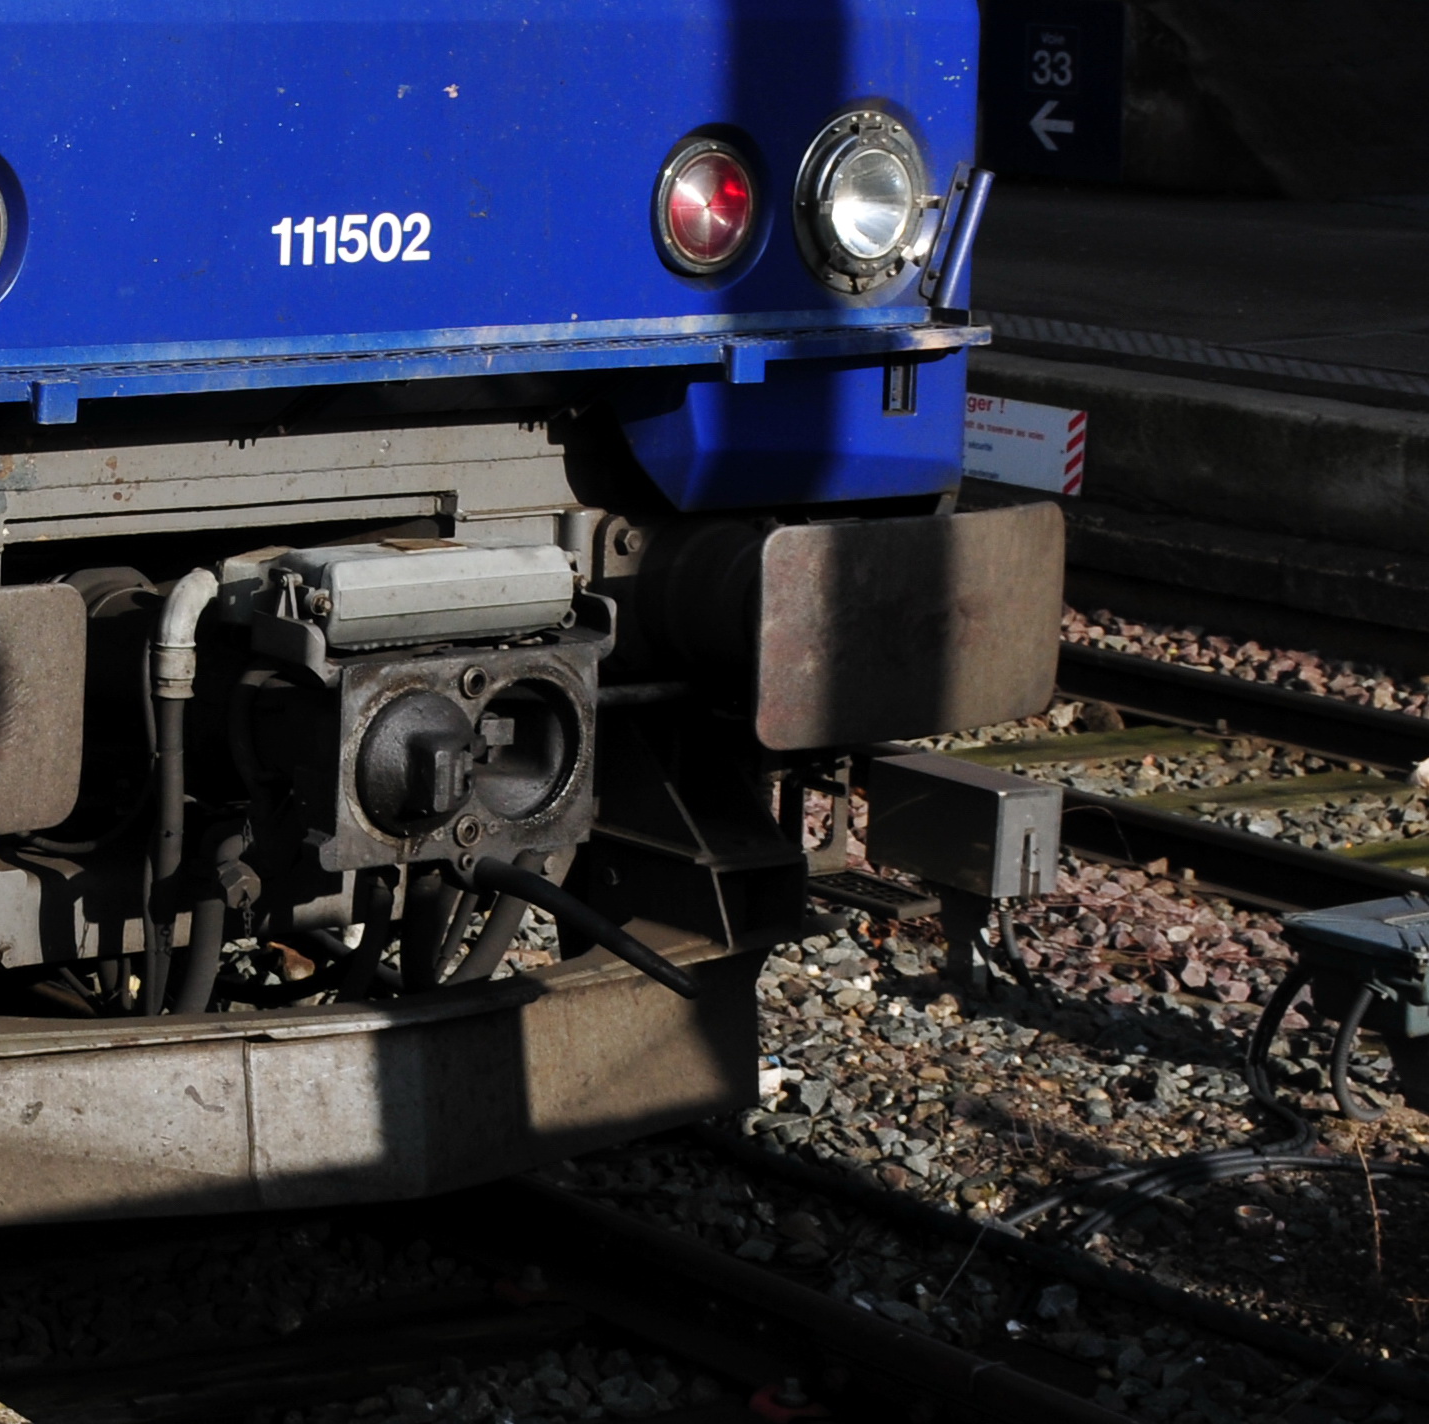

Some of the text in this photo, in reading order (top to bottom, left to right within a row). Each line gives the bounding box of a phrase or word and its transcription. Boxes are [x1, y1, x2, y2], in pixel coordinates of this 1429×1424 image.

[1032, 49, 1072, 87] 33
[271, 212, 431, 266] 111502
[966, 396, 993, 413] ger
